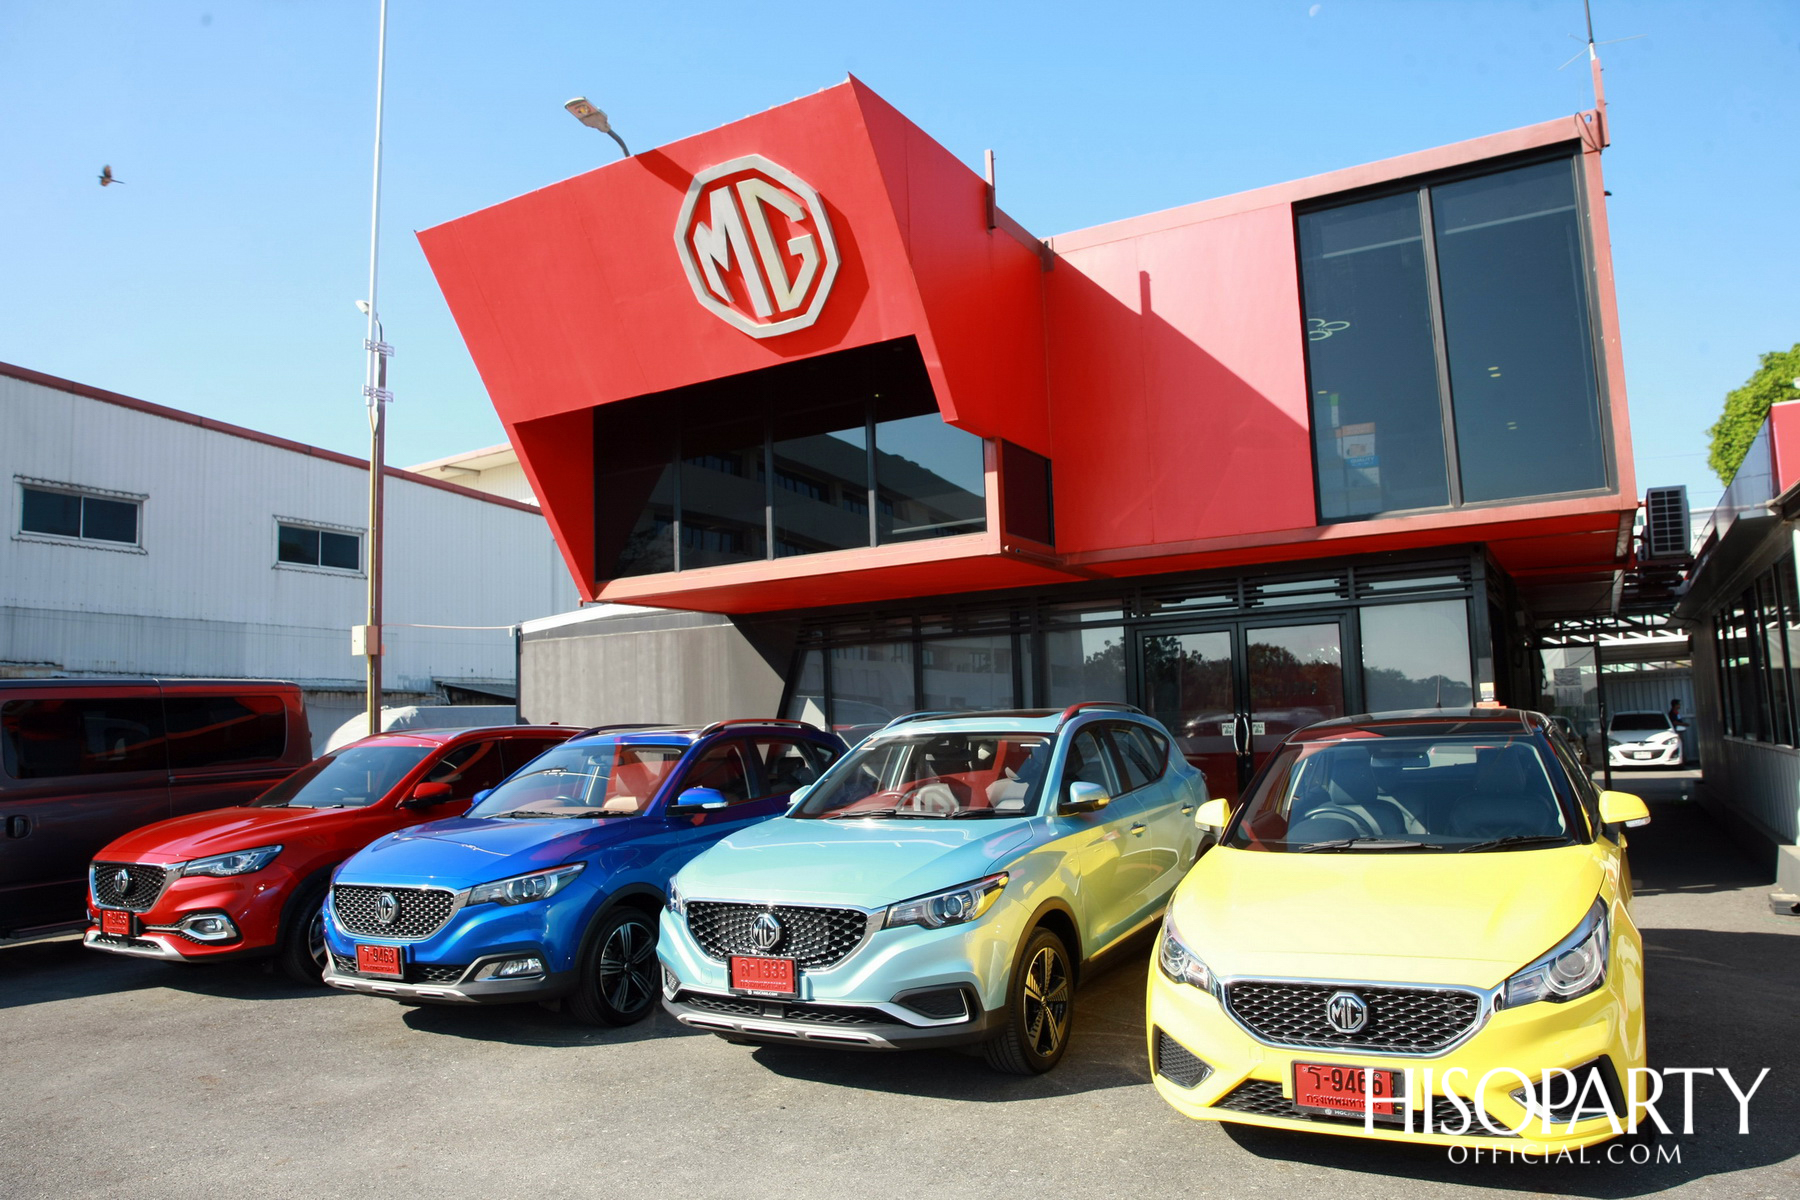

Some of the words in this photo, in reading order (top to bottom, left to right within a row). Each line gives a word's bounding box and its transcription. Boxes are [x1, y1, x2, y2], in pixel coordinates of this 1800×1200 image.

[690, 175, 823, 320] MG
[376, 895, 394, 921] MG
[752, 916, 776, 947] MG
[1330, 996, 1364, 1030] MG
